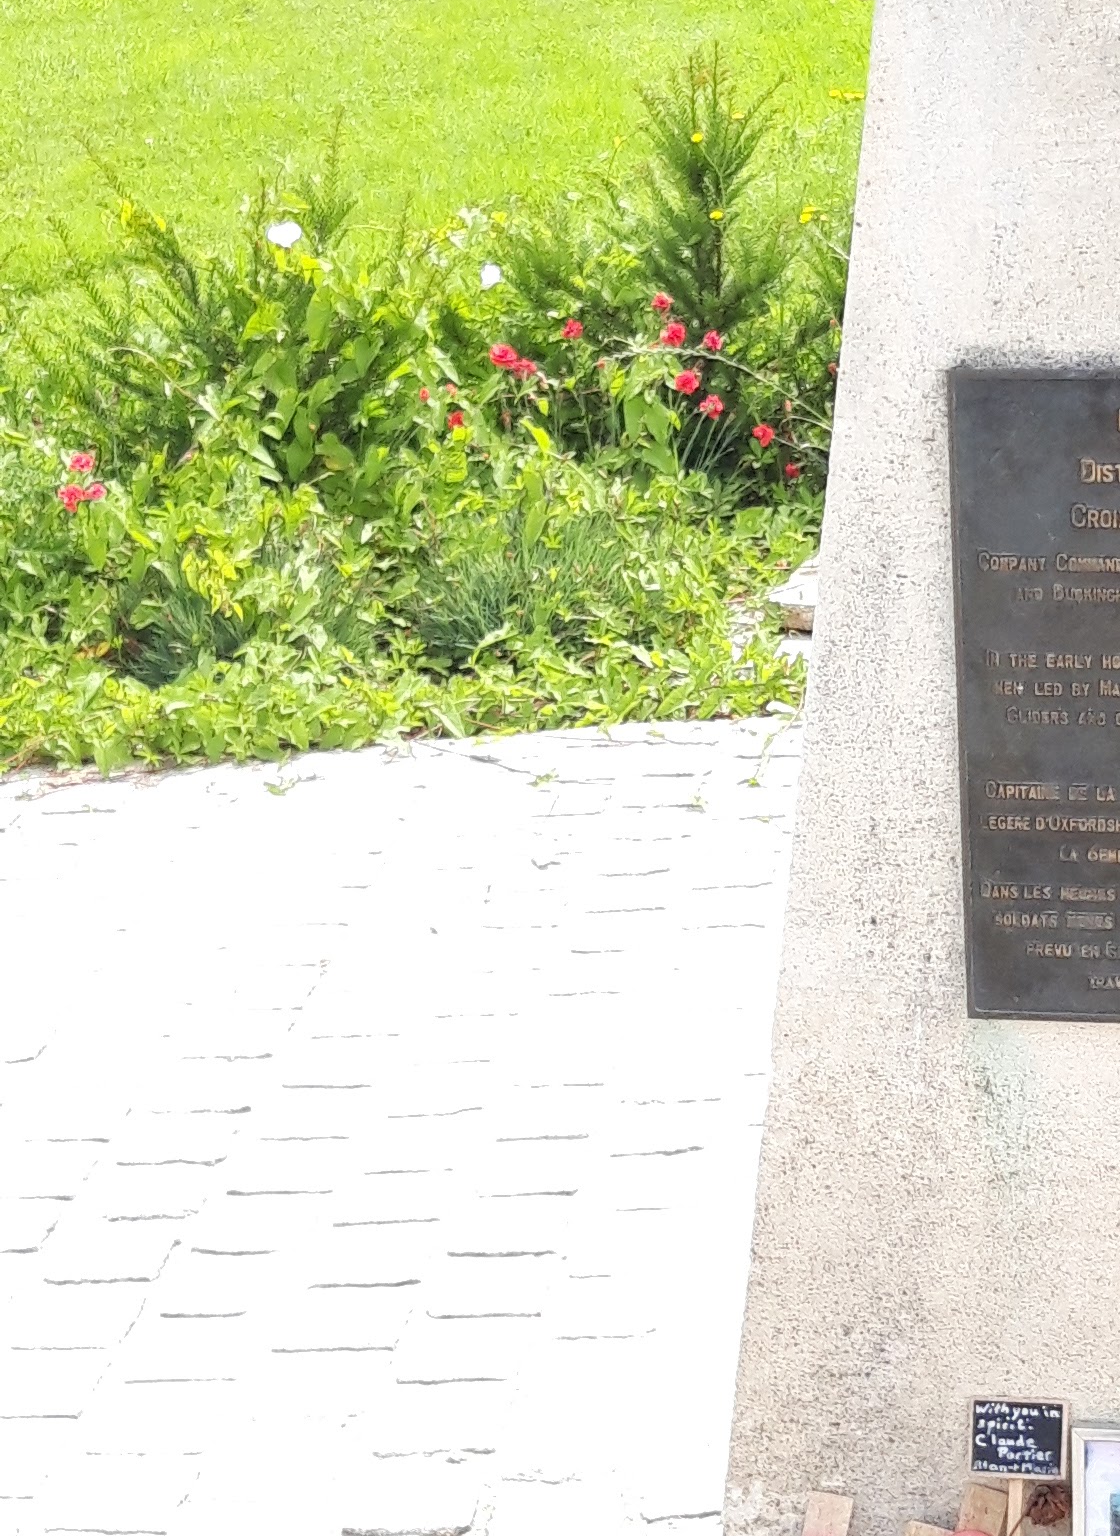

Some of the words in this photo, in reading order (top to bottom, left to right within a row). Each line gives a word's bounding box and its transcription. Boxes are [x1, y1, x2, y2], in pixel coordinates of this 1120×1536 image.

[1010, 654, 1036, 668] THE
[1046, 654, 1092, 669] EARLY
[1034, 683, 1062, 696] LED
[1071, 683, 1090, 697] BY
[1096, 787, 1115, 801] LA
[1024, 886, 1051, 899] LES
[976, 1403, 1009, 1414] With
[1013, 1407, 1039, 1420] you
[1042, 1405, 1060, 1417] in
[975, 1434, 1037, 1448] Claude
